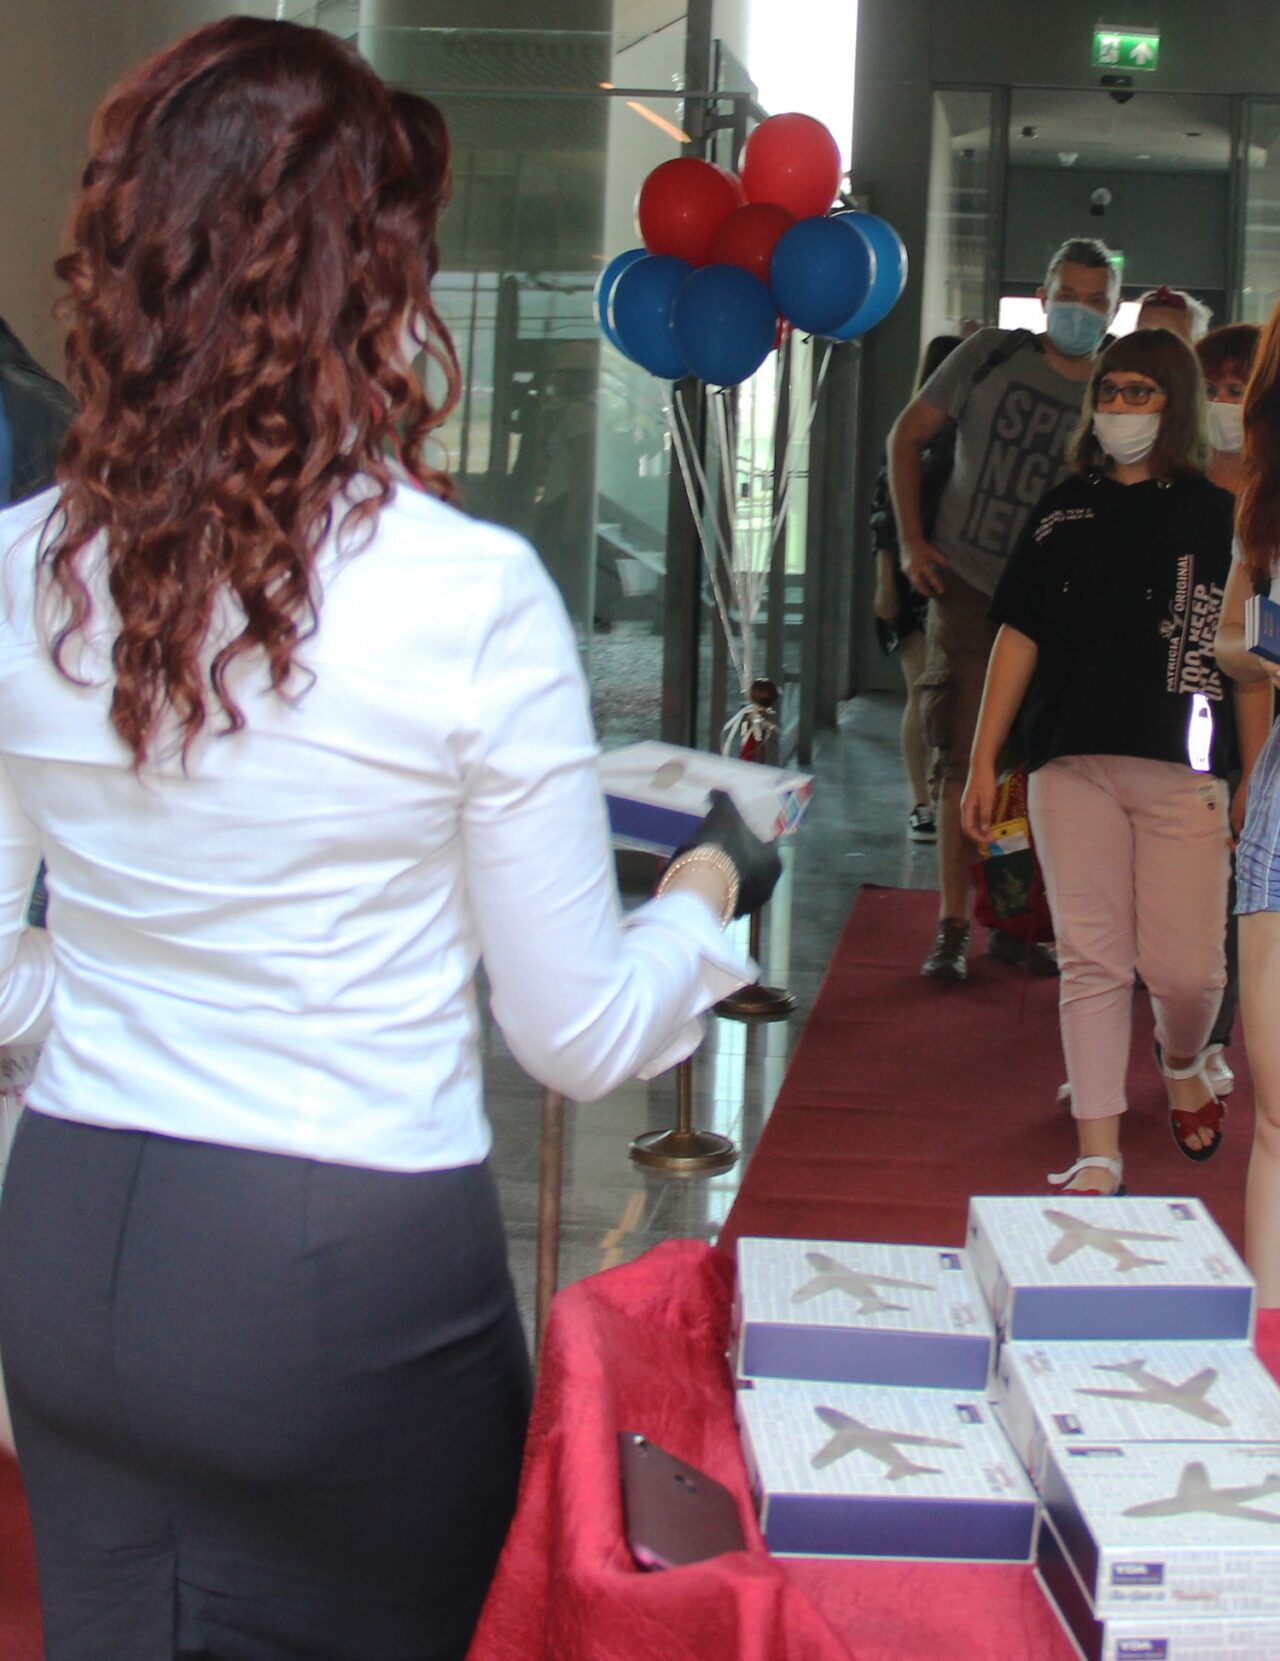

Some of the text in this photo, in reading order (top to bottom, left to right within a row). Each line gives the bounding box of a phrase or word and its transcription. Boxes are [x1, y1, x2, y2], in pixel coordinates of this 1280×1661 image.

[1174, 554, 1190, 613] ORIGINAL
[1180, 583, 1210, 694] TOO KEEP
